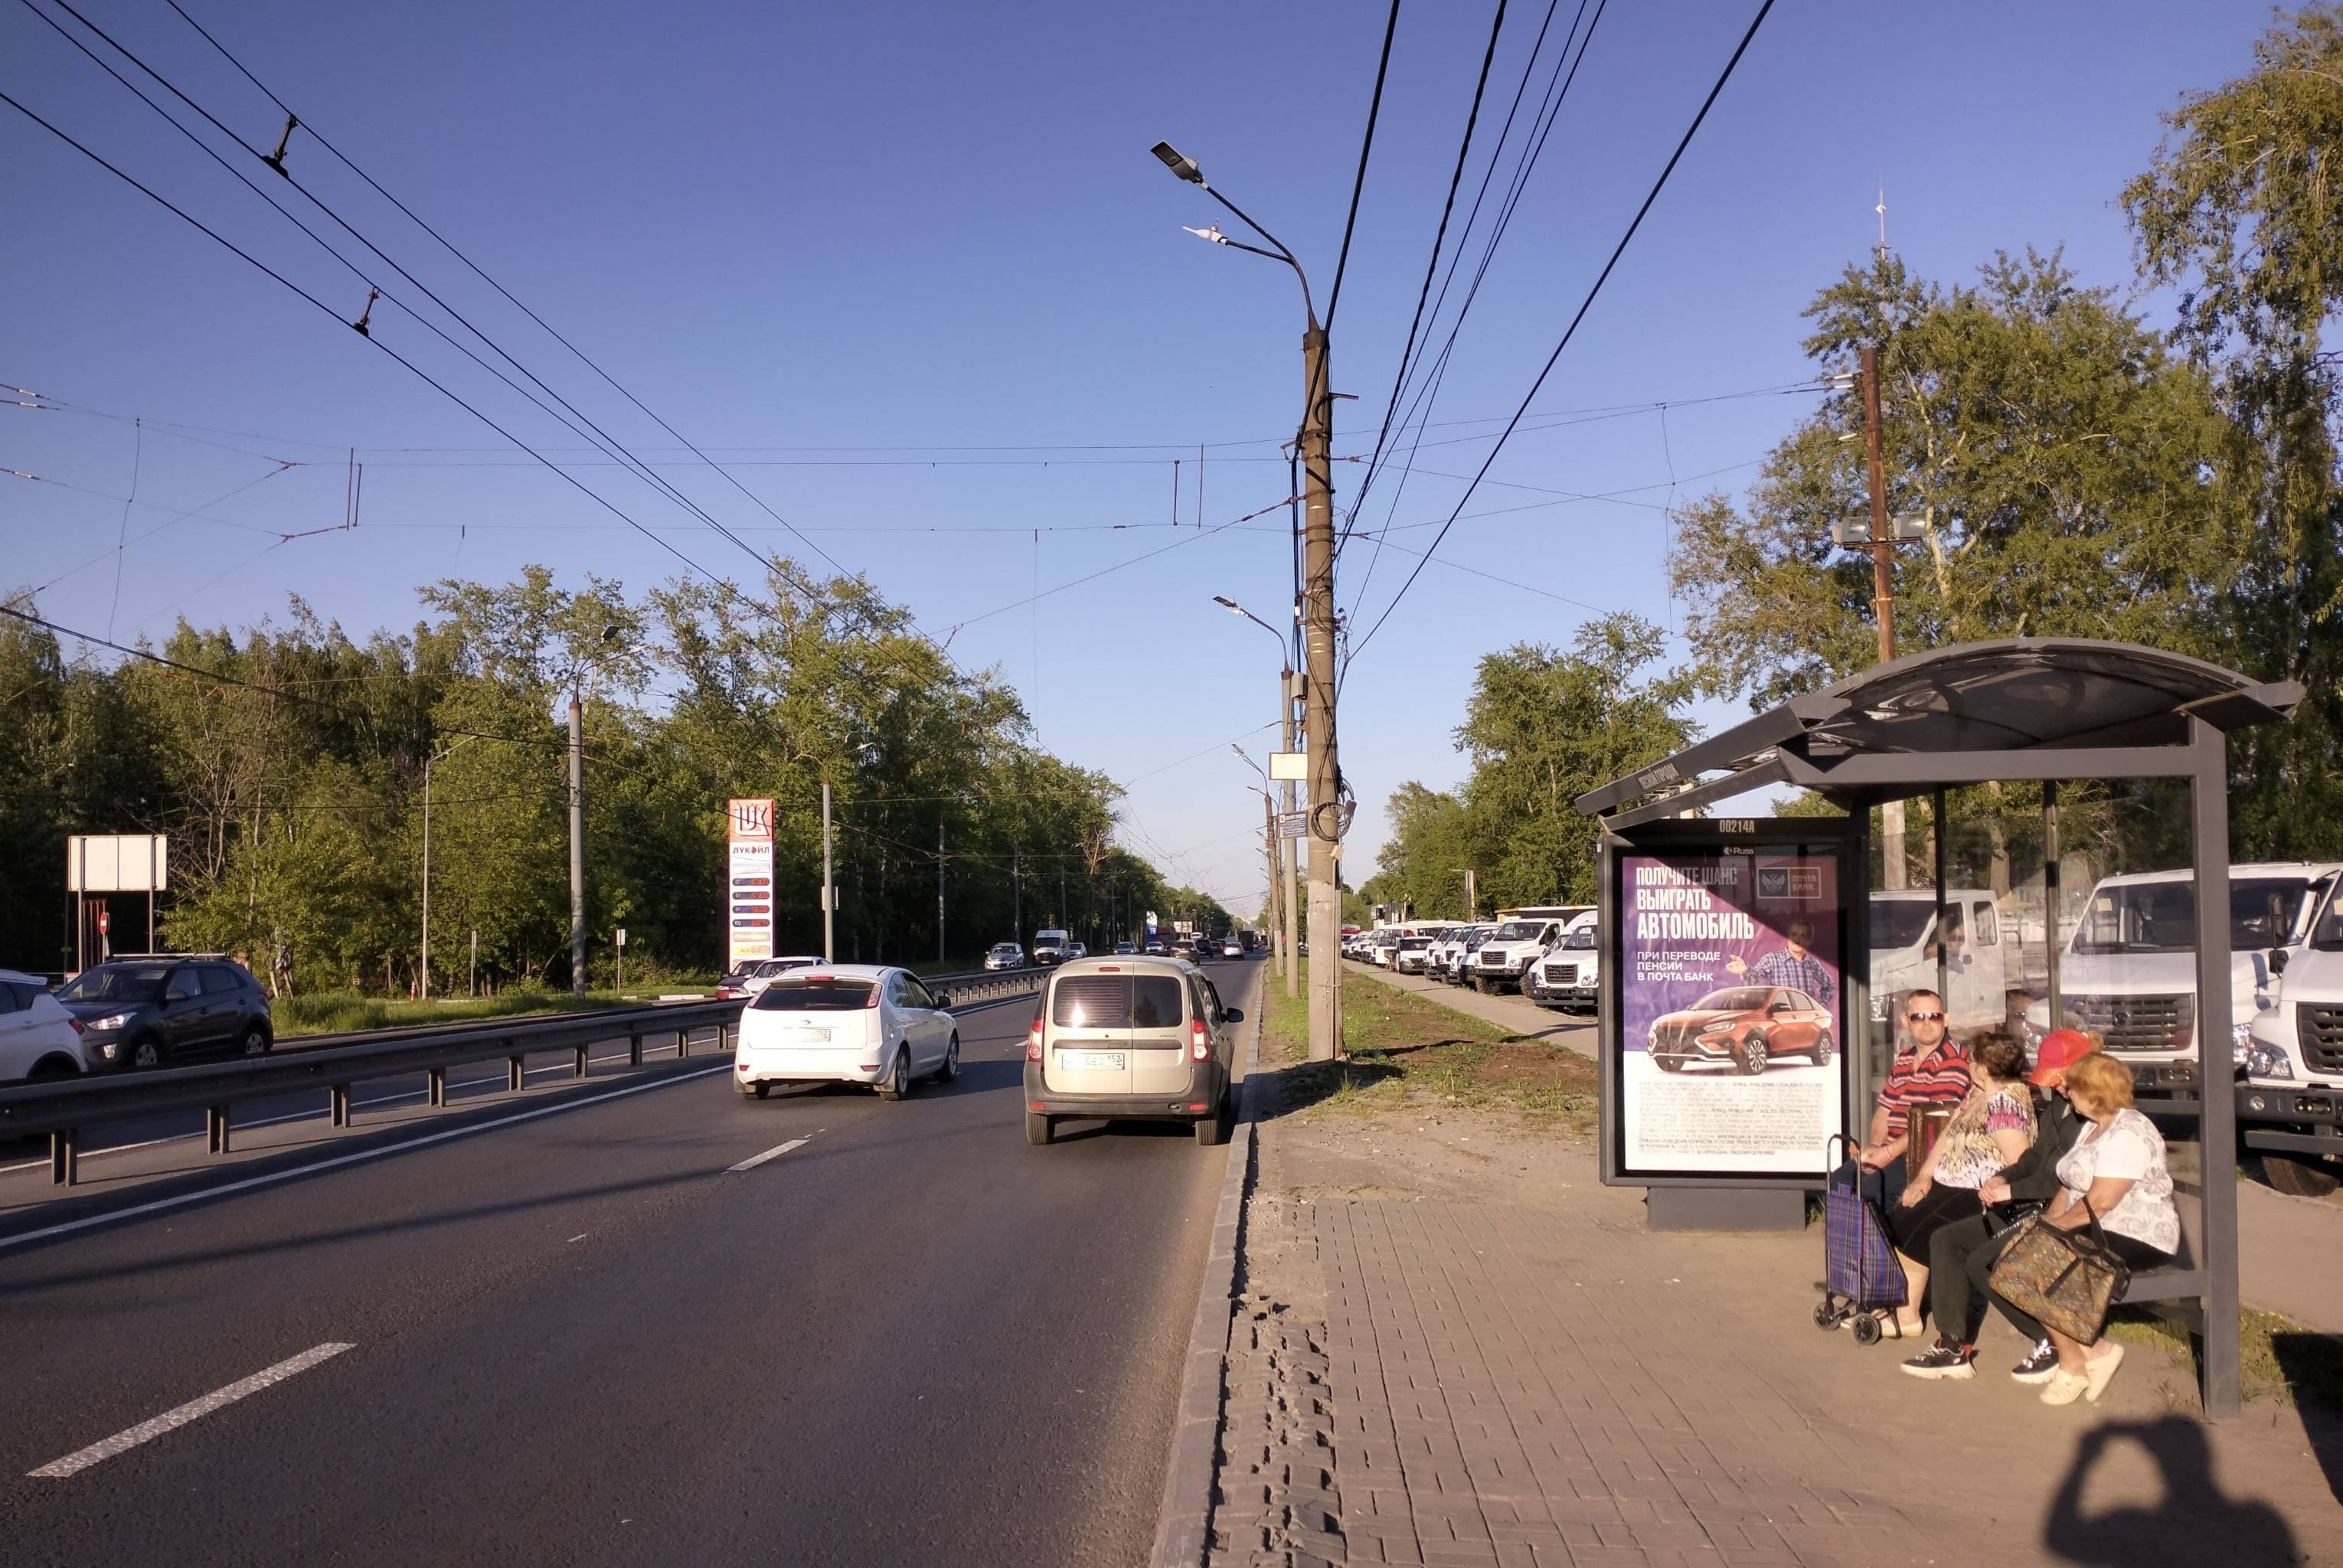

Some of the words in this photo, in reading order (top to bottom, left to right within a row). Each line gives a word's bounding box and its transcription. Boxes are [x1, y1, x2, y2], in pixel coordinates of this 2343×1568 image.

[1719, 819, 1755, 833] 00214А
[733, 844, 770, 854] ЛУКОЙЛ
[1733, 847, 1755, 855] Russ
[1636, 867, 1699, 886] ПОЛУЧИТЕ
[1701, 867, 1738, 886] ШАНС
[1636, 888, 1712, 910] ВЫИГРАТЬ
[1636, 912, 1755, 940] АВТОМОБИЛЬ
[1637, 951, 1660, 960] ПРИ
[1662, 951, 1721, 962] ПЕРЕВОДЕ
[1637, 962, 1683, 971] ПЕНСИИ
[1637, 972, 1645, 981] В
[1647, 972, 1683, 981] ПОЧТА
[1685, 972, 1714, 982] БАНК
